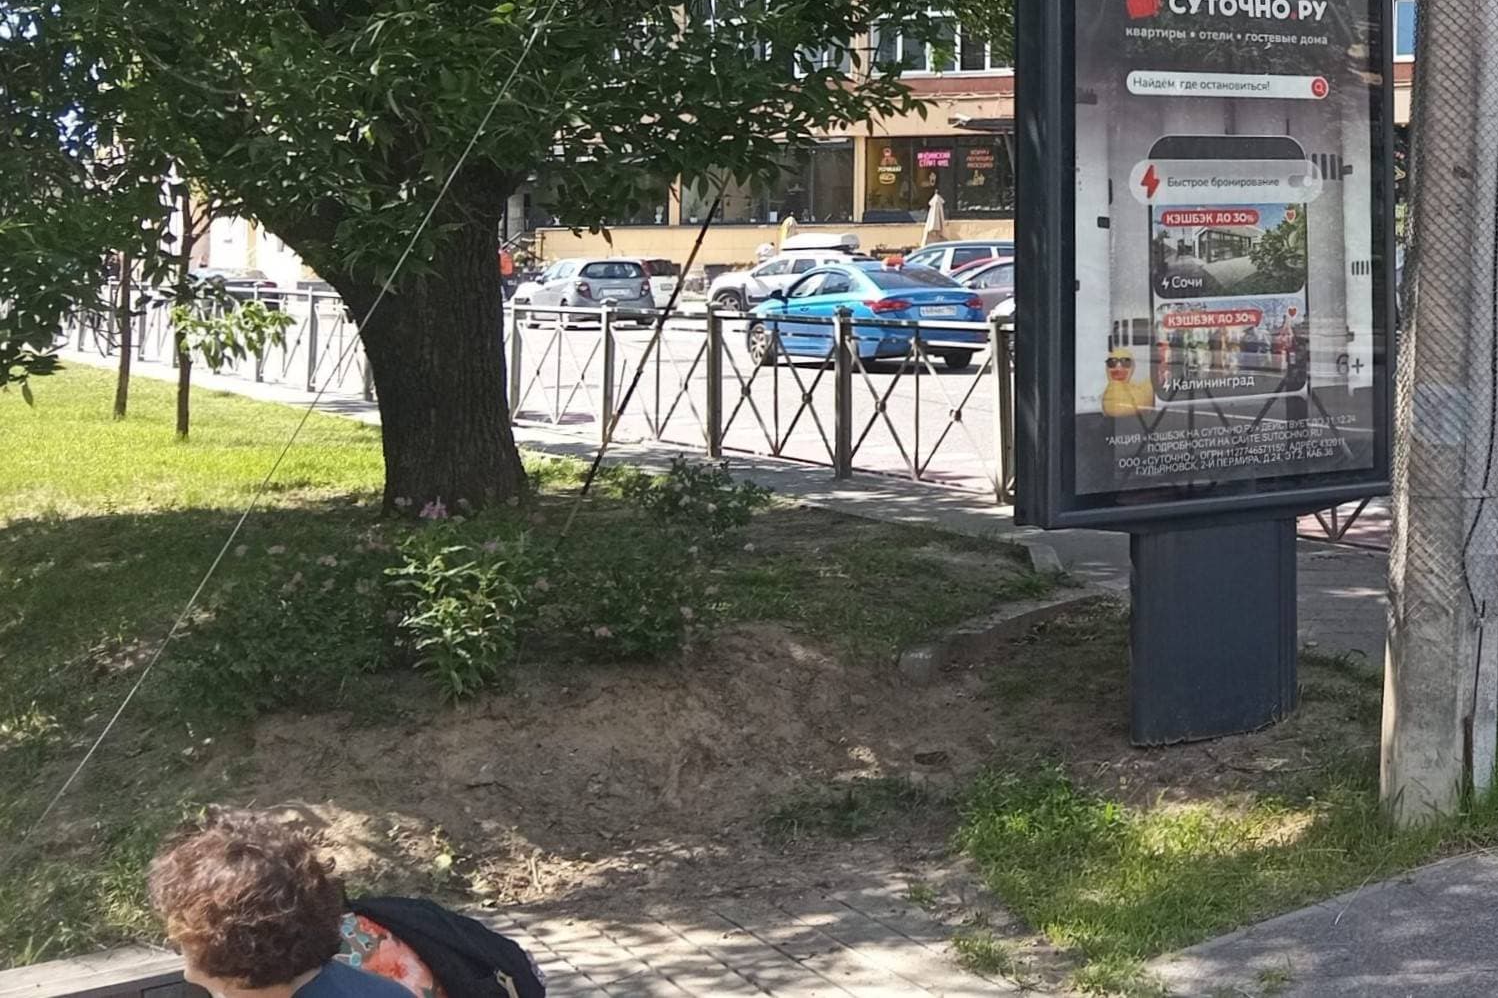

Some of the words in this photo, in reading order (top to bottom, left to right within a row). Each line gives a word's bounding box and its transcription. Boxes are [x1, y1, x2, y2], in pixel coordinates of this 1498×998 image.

[1125, 27, 1186, 42] квартиры
[1199, 31, 1233, 41] отели
[1245, 33, 1297, 44] гостевые
[1300, 35, 1328, 46] дома
[1180, 80, 1198, 91] где
[1200, 80, 1270, 92] остановиться!
[1167, 177, 1208, 189] Быстрое
[1210, 176, 1280, 189] бронирование
[1166, 213, 1213, 225] КЭШБЭК
[1215, 213, 1233, 224] ДО
[1233, 213, 1255, 223] 30%
[1171, 276, 1203, 289] Сочи
[1168, 314, 1215, 326] КЭШБЭК
[1217, 313, 1233, 324] ДО
[1235, 313, 1256, 323] 30%
[1336, 353, 1364, 374] 6+
[1172, 375, 1255, 391] Калининград
[1147, 437, 1216, 453] ПОДРОБНОСТИ
[1217, 436, 1231, 447] НА
[1231, 433, 1261, 445] САЙТЕ
[1262, 428, 1323, 442] SUTOCHNO.RU
[1186, 429, 1200, 439] НА
[1119, 457, 1140, 468] ООО
[1200, 449, 1224, 460] ОГРН
[1200, 458, 1215, 469] 2-Й
